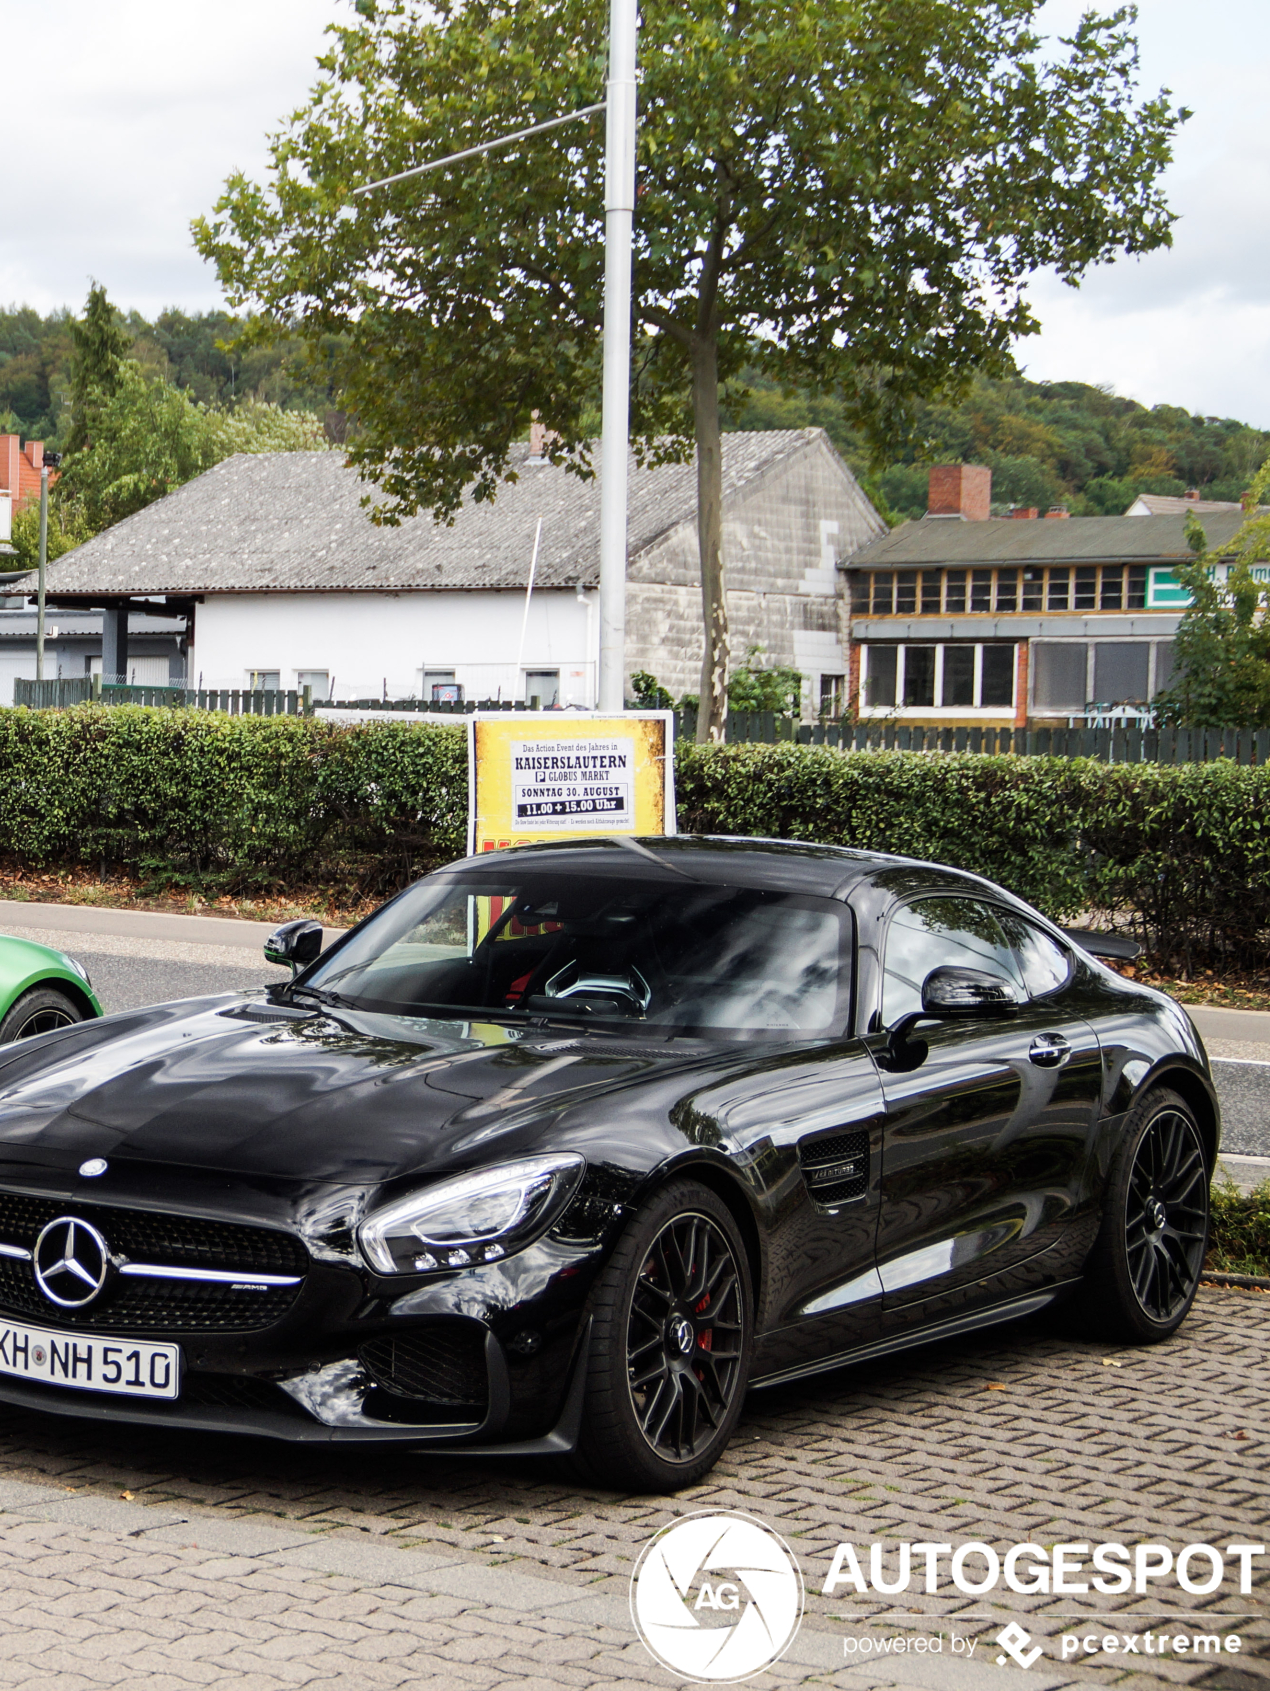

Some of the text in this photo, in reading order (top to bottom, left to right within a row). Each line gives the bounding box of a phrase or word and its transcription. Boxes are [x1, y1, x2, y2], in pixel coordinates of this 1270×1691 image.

[523, 742, 618, 753] Das Action Event des Jahres in
[515, 755, 627, 770] KAISERSLAUTERN
[549, 771, 578, 782] GLOBUS
[581, 770, 610, 781] MARKT
[522, 787, 620, 797] SONNTAG 30. AUGUST
[526, 803, 553, 815] 11.00
[565, 800, 593, 812] 15.00
[595, 799, 617, 810] Uhr
[50, 1339, 93, 1381] NH
[102, 1347, 171, 1389] 510
